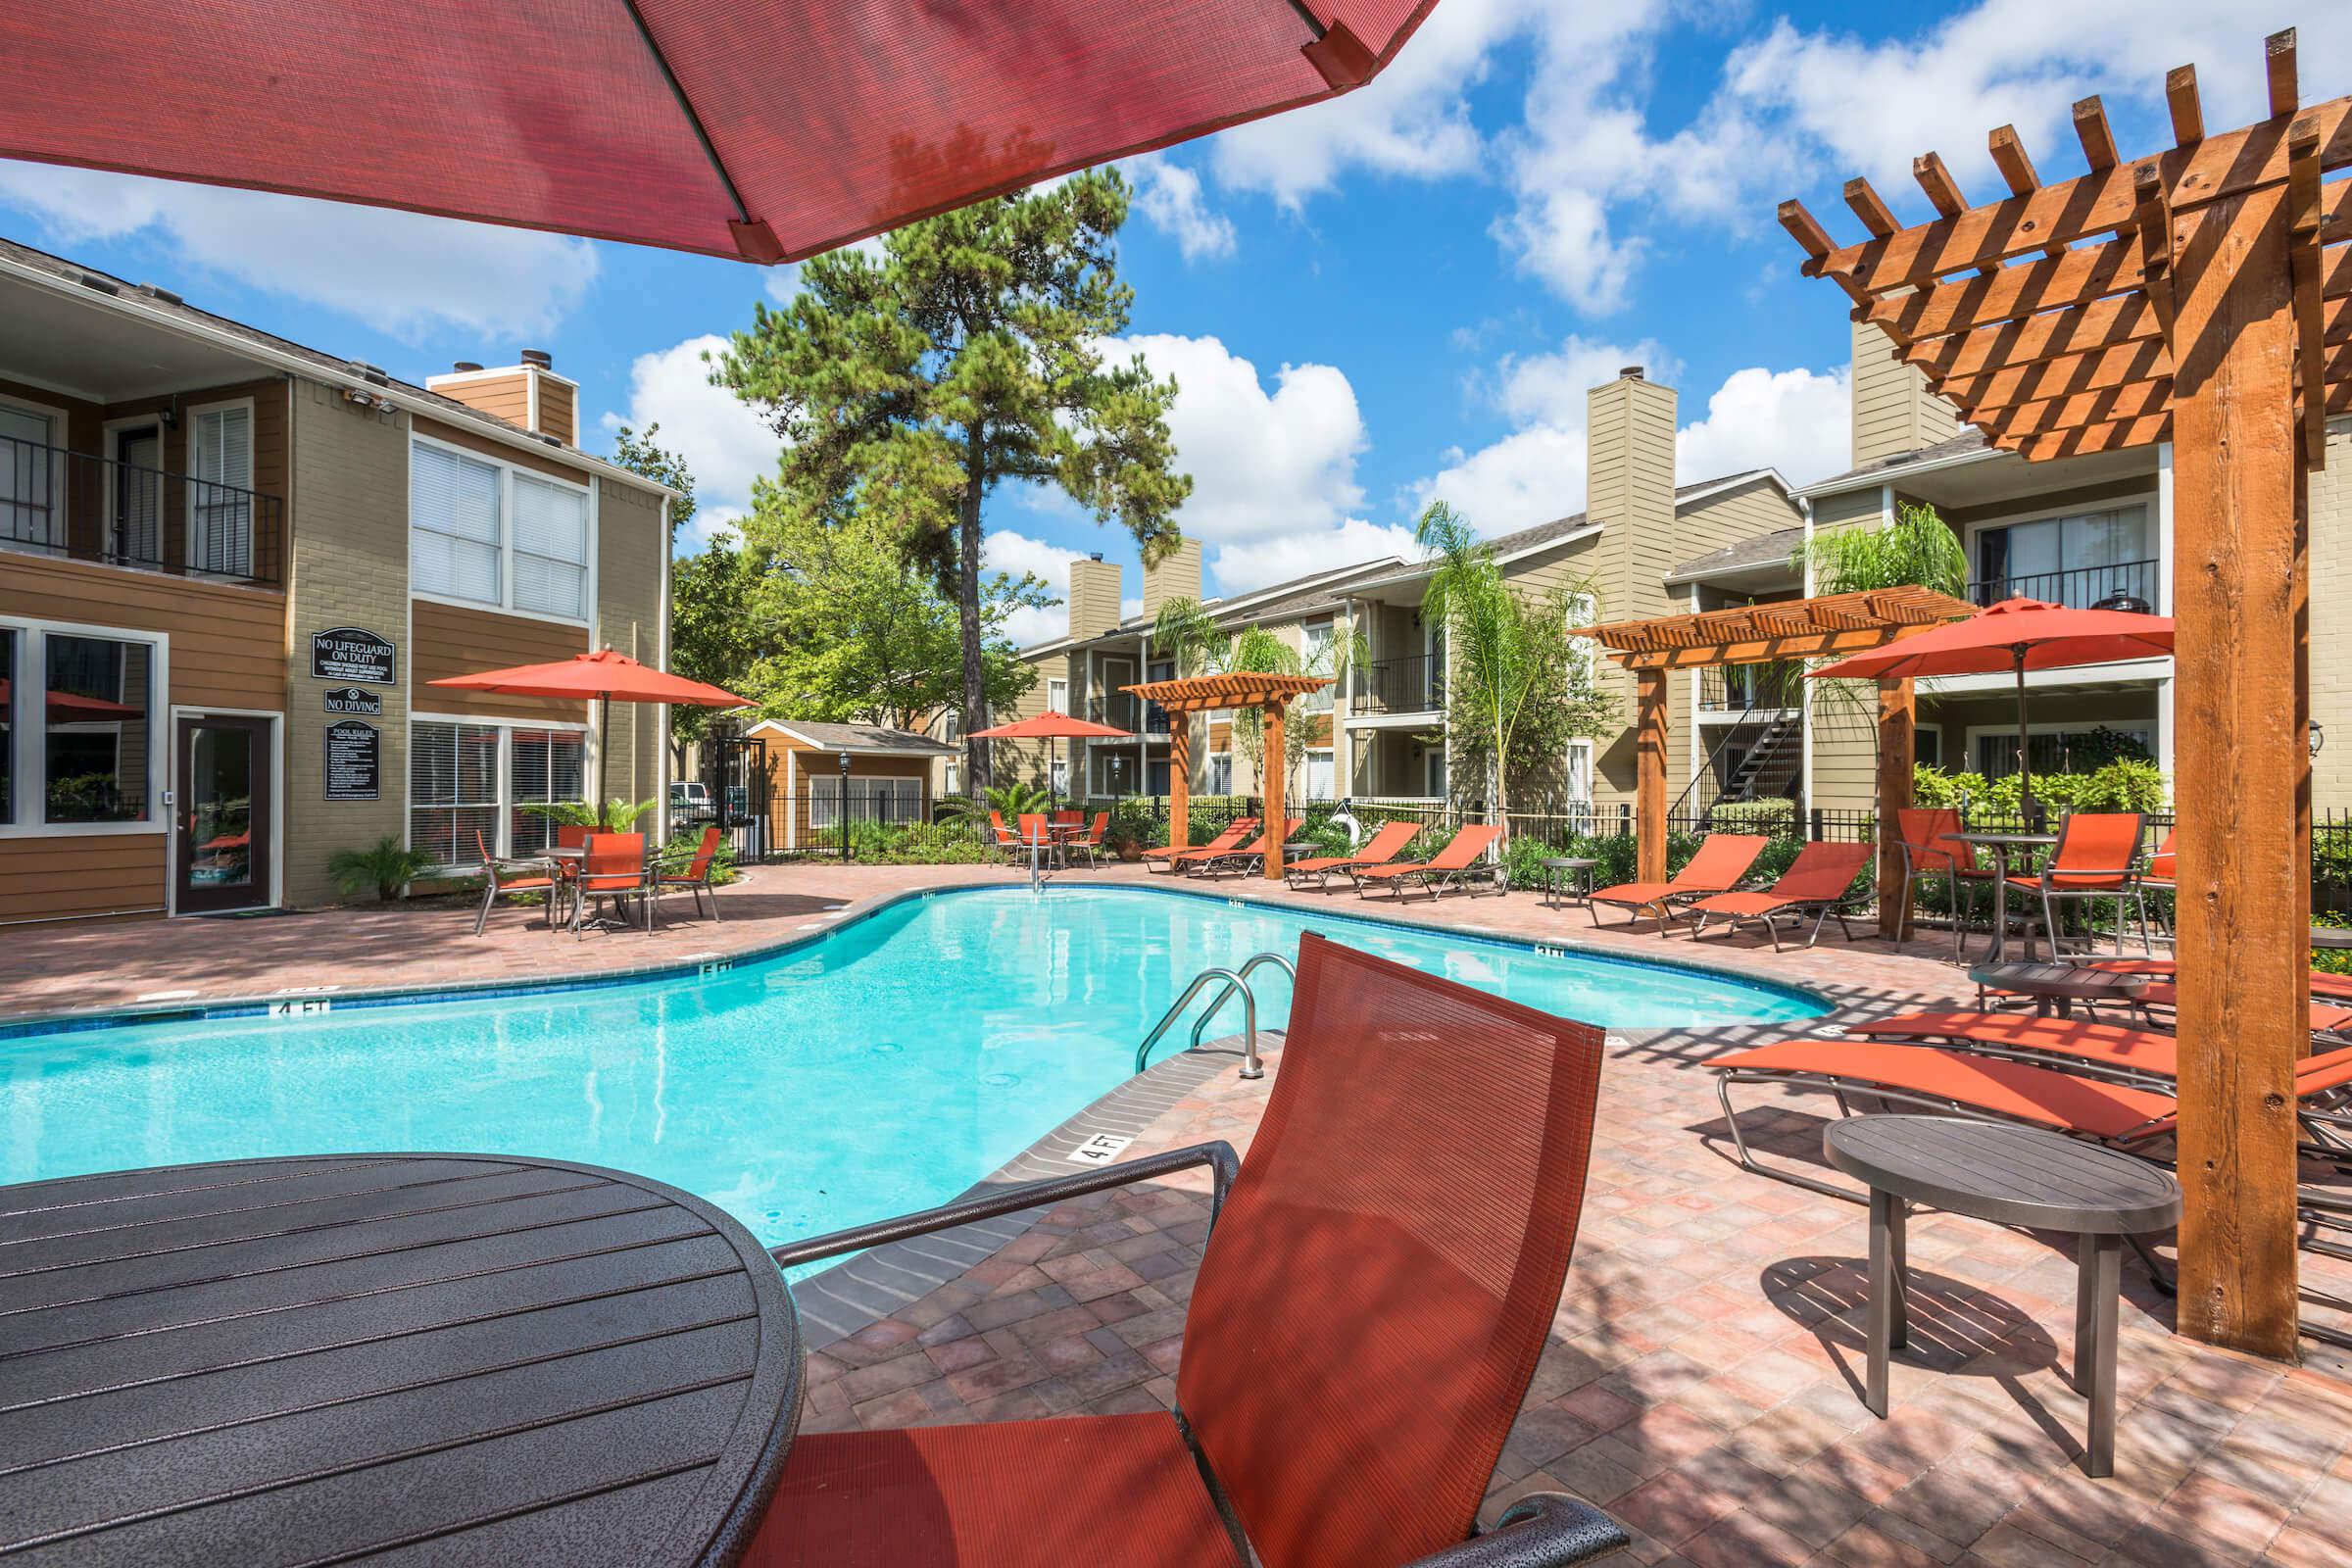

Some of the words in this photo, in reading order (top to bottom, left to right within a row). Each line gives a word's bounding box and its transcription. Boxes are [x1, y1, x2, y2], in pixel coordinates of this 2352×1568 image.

[317, 639, 333, 650] NO
[335, 641, 392, 657] LIFEGUARD
[332, 651, 347, 661] ON
[350, 654, 376, 664] DUTY
[327, 699, 343, 710] NO
[345, 700, 378, 712] DIVING
[303, 1000, 327, 1012] FT
[1091, 1135, 1126, 1149] FT
[1081, 1150, 1109, 1159] 4
